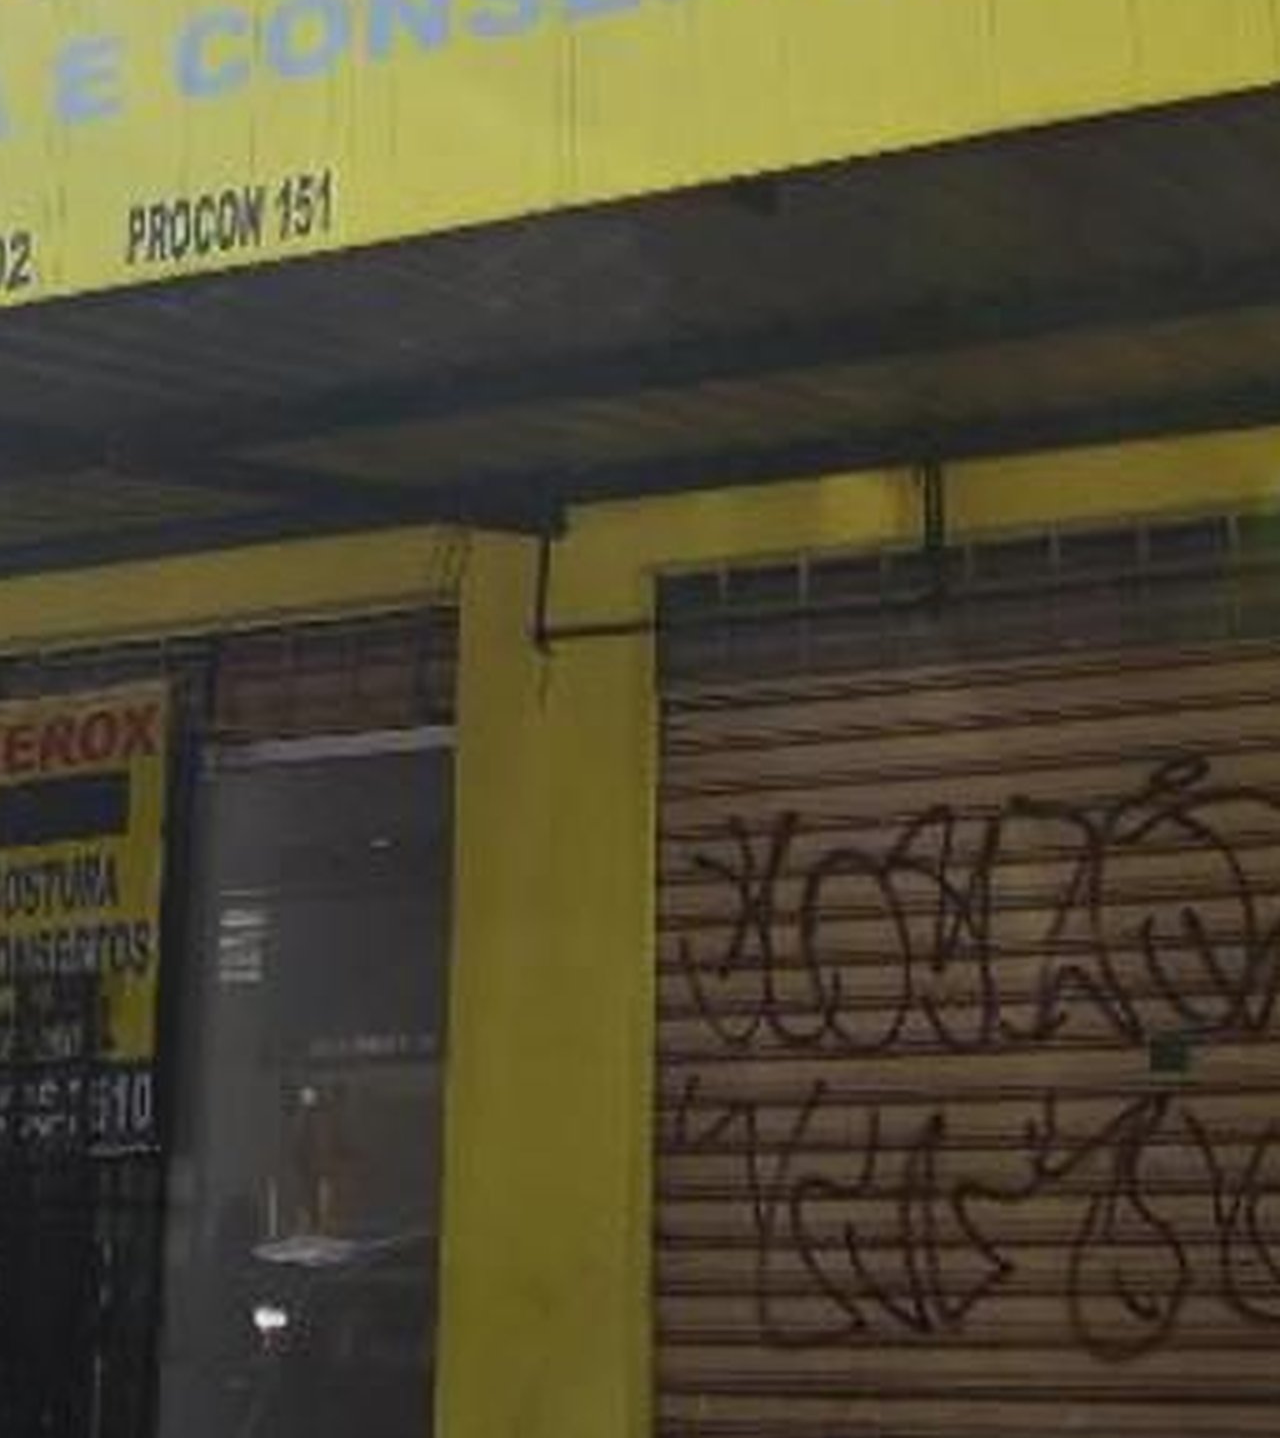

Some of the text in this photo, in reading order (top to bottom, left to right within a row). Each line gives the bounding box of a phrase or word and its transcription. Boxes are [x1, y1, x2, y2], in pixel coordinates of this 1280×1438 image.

[54, 35, 117, 125] E
[125, 182, 271, 266] PROCON
[276, 171, 335, 244] 151
